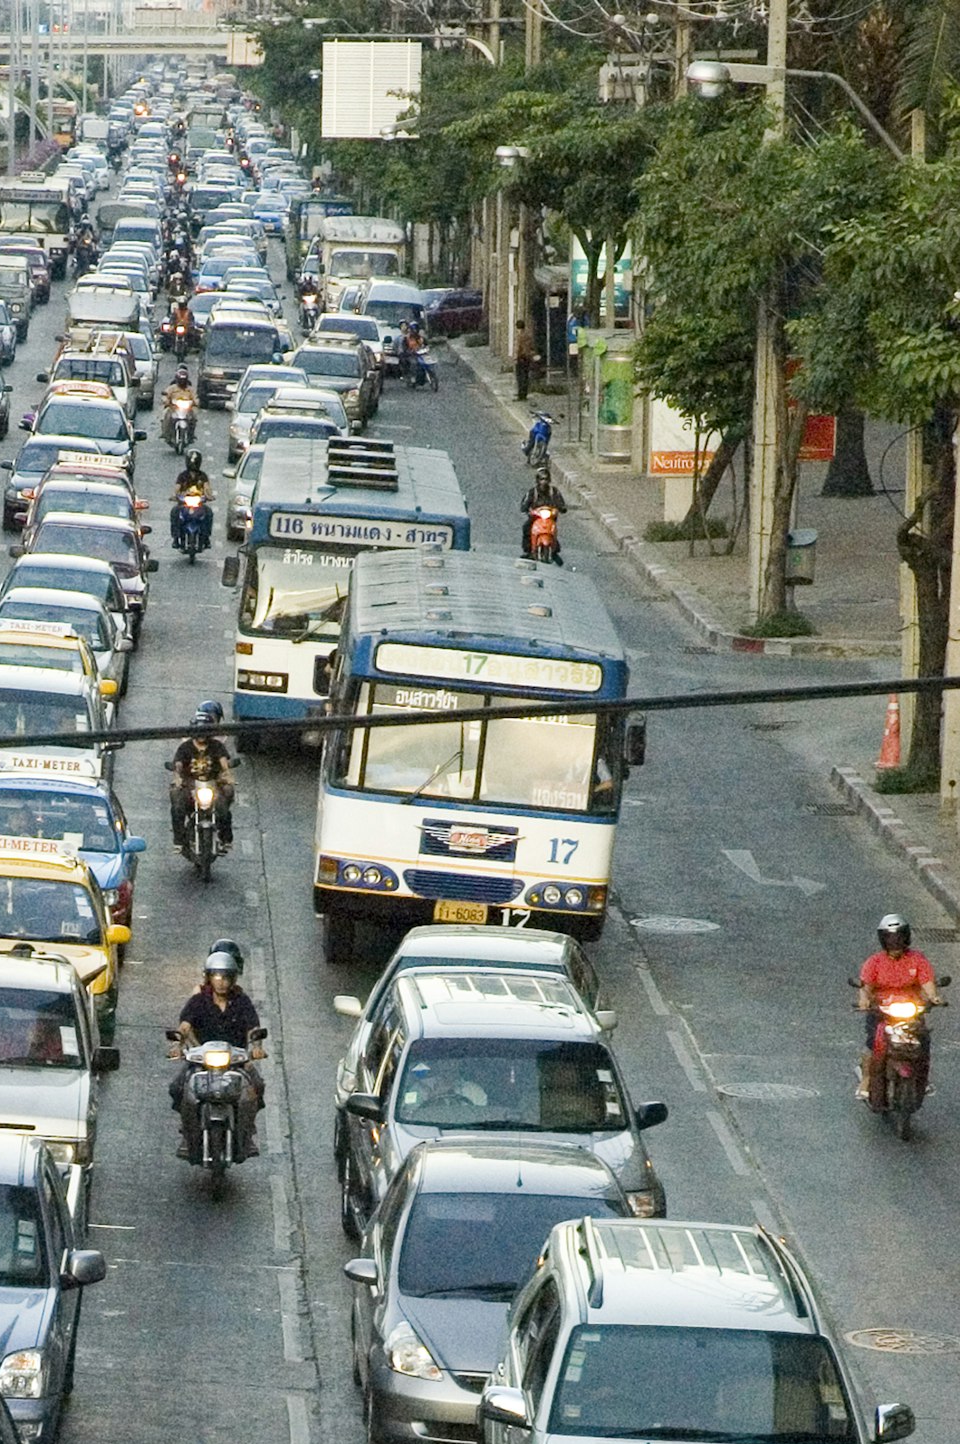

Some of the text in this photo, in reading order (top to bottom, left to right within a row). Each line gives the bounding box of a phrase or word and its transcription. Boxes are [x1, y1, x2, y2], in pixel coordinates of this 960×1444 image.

[275, 517, 304, 534] 116
[311, 521, 392, 541] หนามแดง
[405, 528, 449, 546] สาทร
[282, 548, 314, 566] สำโรง
[463, 653, 489, 675] 17
[546, 837, 579, 865] 17
[500, 908, 531, 928] 17
